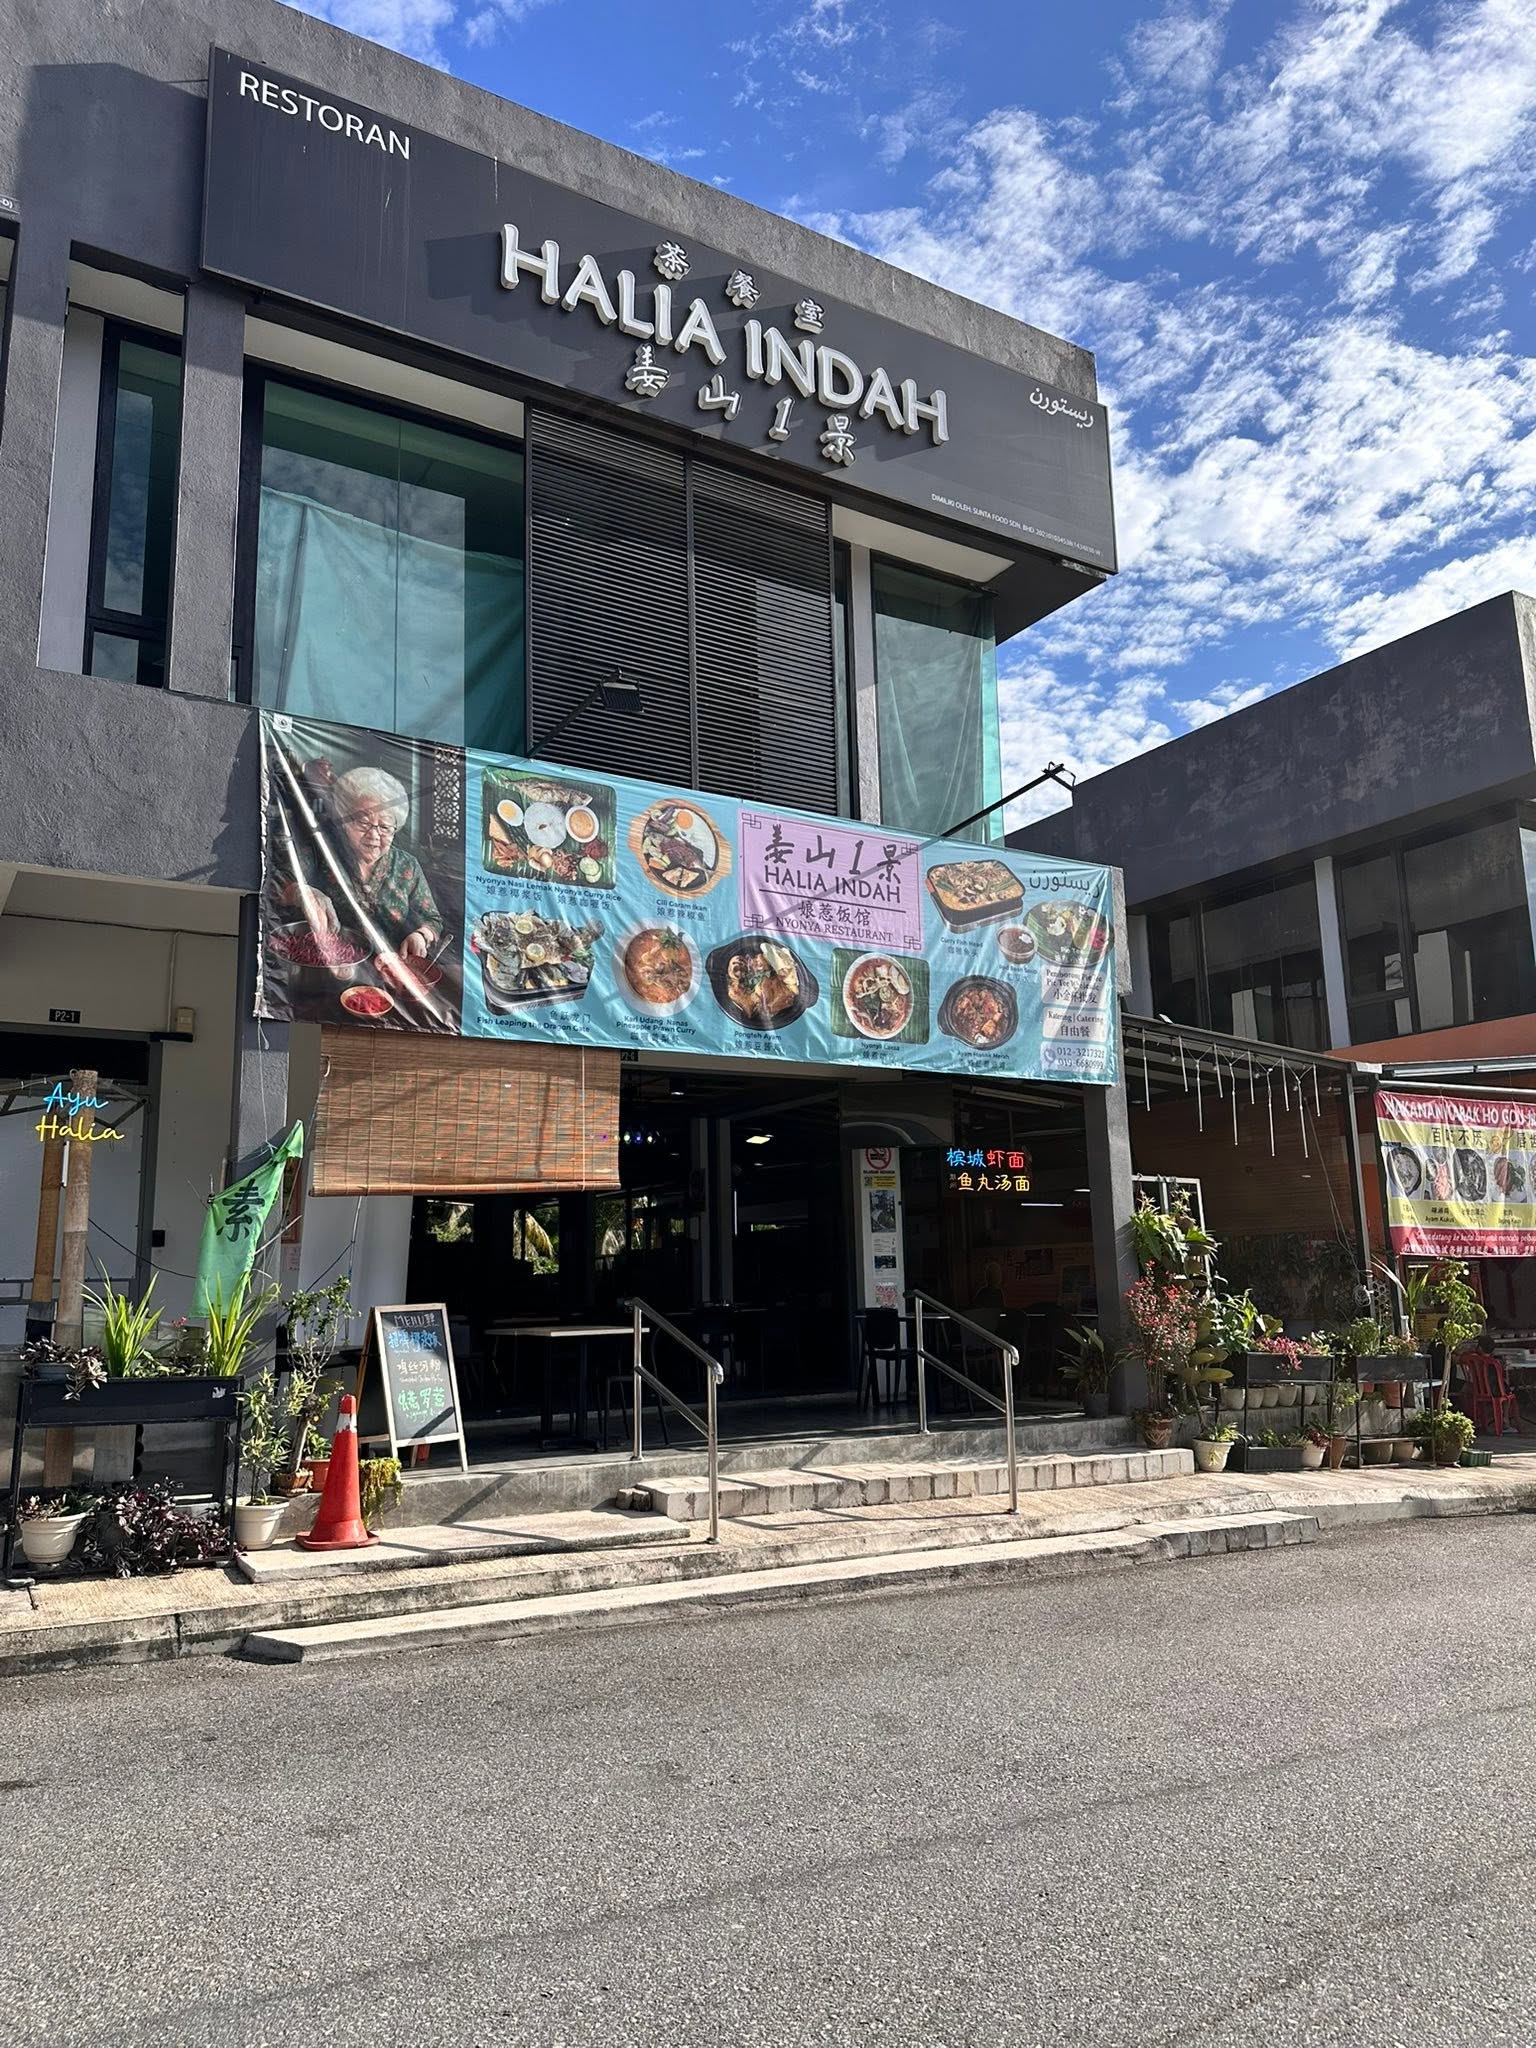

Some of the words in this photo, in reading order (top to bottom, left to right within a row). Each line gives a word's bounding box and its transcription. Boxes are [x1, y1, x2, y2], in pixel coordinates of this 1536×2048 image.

[240, 71, 411, 160] RESTORAN
[655, 240, 825, 334] 茶餐室
[501, 223, 728, 365] HALIA
[745, 319, 950, 446] INDAH
[1029, 387, 1094, 428] ريستورن
[992, 513, 1009, 525] FOOD
[764, 824, 902, 884] 姜山1景
[476, 875, 506, 886] Nyonya
[508, 877, 525, 887] Nasi
[526, 881, 553, 892] Lemak
[554, 886, 582, 896] Nyonya
[583, 889, 604, 899] Curry
[605, 893, 622, 901] Rice
[764, 865, 828, 893] HALIA
[834, 876, 901, 904] INDAH
[798, 900, 871, 926] 娘惹饭馆
[776, 916, 823, 935] NYONYA
[824, 921, 894, 943] RESTAURANT
[55, 1010, 76, 1021] P2-1
[495, 1018, 527, 1028] Leaping
[640, 1016, 663, 1025] Udang
[616, 1021, 651, 1031] Pineapple
[653, 1024, 675, 1032] Prawn
[676, 1026, 696, 1036] Curry
[1060, 1024, 1091, 1038] 自由餐
[43, 1082, 109, 1116] Ayu
[1483, 1107, 1499, 1124] HO
[35, 1114, 125, 1142] Halia
[946, 1148, 1026, 1169] 槟城虾面
[957, 1172, 1031, 1192] 鱼丸汤面
[216, 1178, 266, 1243] 素
[394, 1315, 425, 1328] MENU
